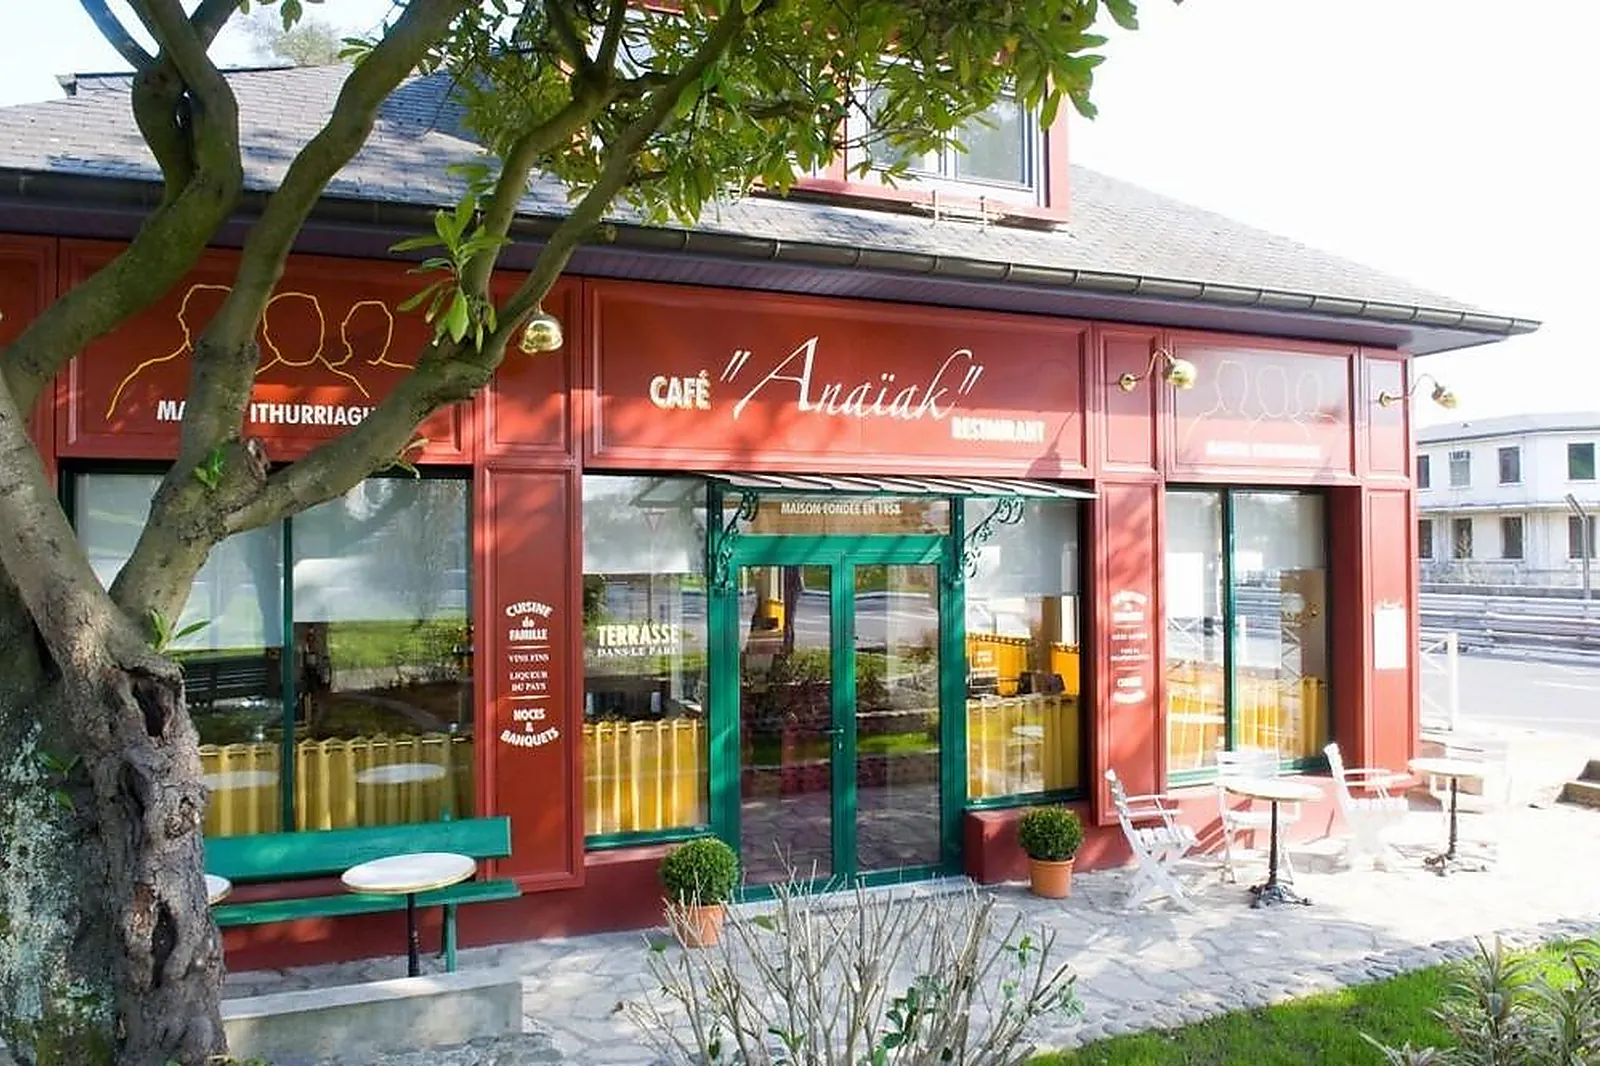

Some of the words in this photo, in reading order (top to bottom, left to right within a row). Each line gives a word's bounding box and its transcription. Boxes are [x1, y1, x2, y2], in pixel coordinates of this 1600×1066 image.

[649, 369, 712, 411] CAFÉ
[780, 502, 821, 514] MAISON
[505, 601, 553, 618] CUISINE
[522, 616, 535, 628] de
[509, 628, 549, 642] FAMILLE
[597, 622, 681, 647] TERRASSE
[511, 683, 524, 692] DU
[525, 682, 547, 691] PAYS
[513, 708, 546, 721] NOCES
[500, 726, 561, 748] BANQUETS
